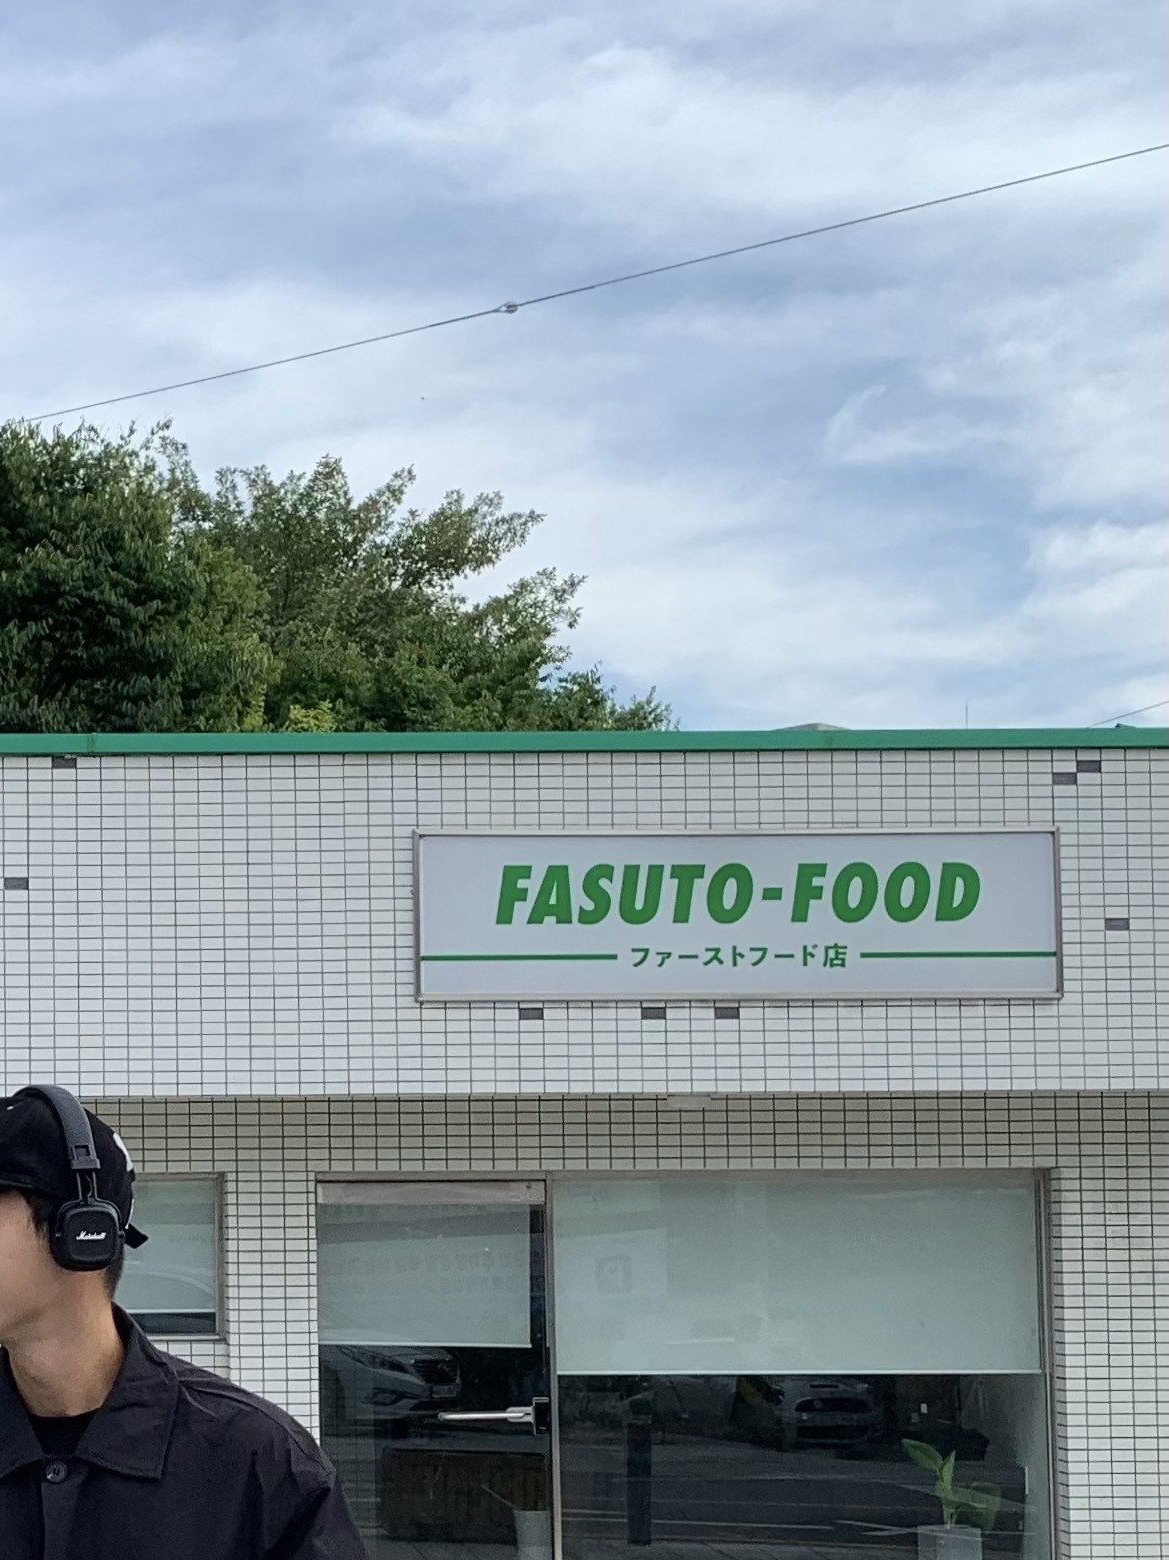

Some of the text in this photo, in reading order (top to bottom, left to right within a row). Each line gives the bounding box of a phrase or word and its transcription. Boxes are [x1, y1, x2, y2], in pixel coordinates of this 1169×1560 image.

[495, 861, 981, 926] FASUTO-FOOD
[630, 943, 848, 969] ファーストフード店
